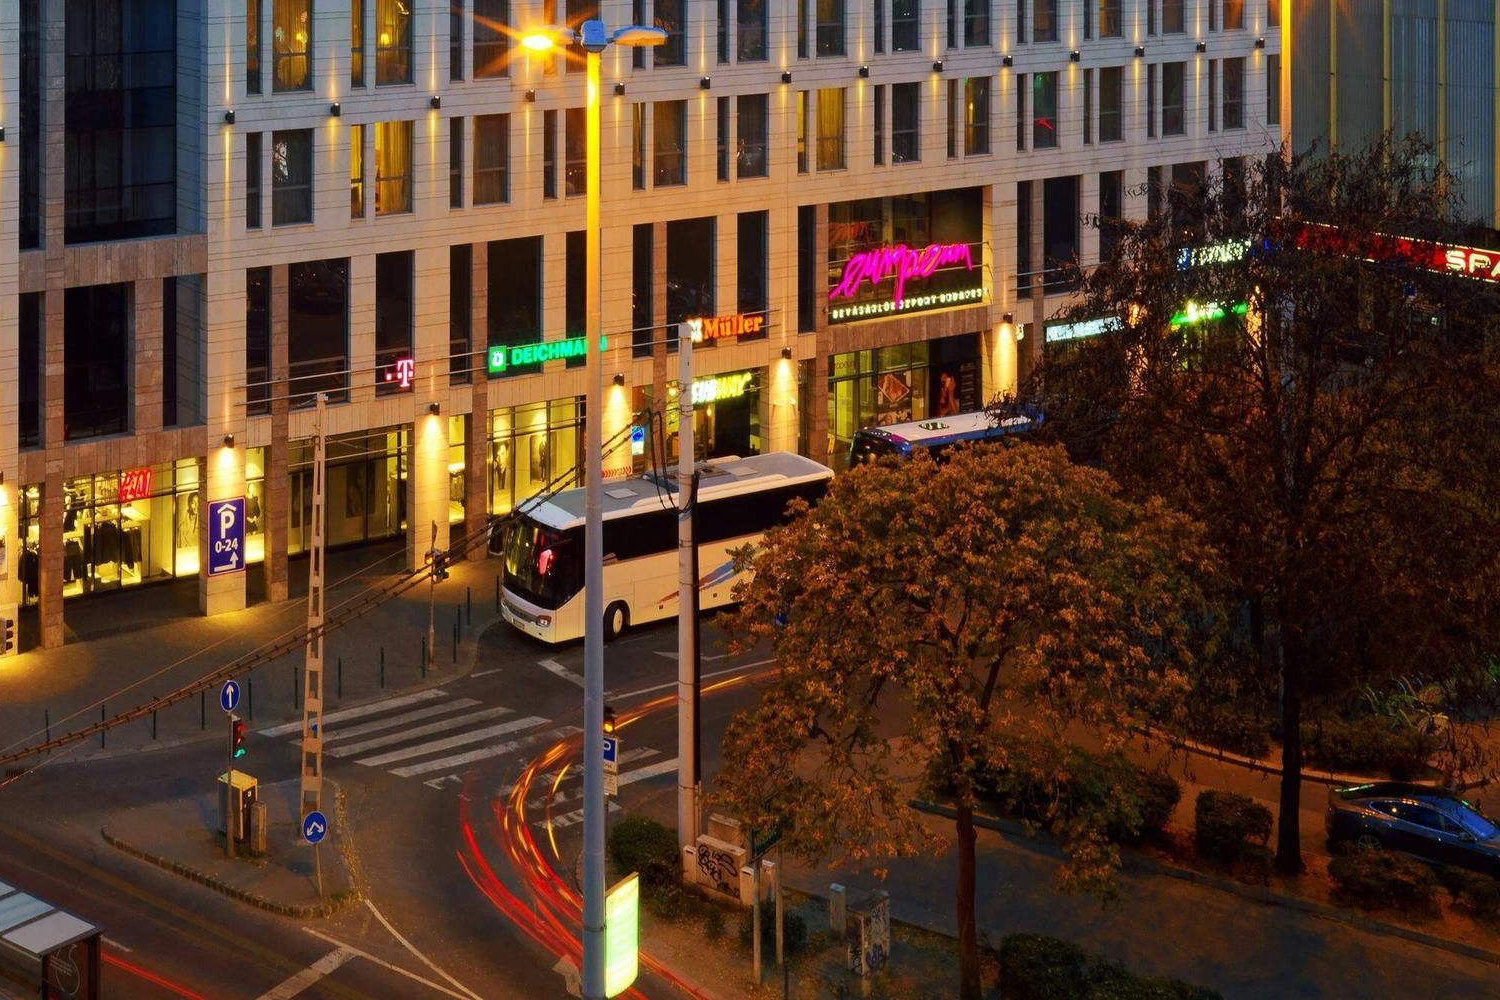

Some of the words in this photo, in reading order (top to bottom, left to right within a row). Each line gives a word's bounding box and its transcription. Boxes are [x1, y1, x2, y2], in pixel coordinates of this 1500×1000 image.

[703, 314, 762, 340] Müller
[511, 335, 606, 366] DEICHMAN
[221, 510, 235, 540] P
[215, 538, 238, 554] 0-24
